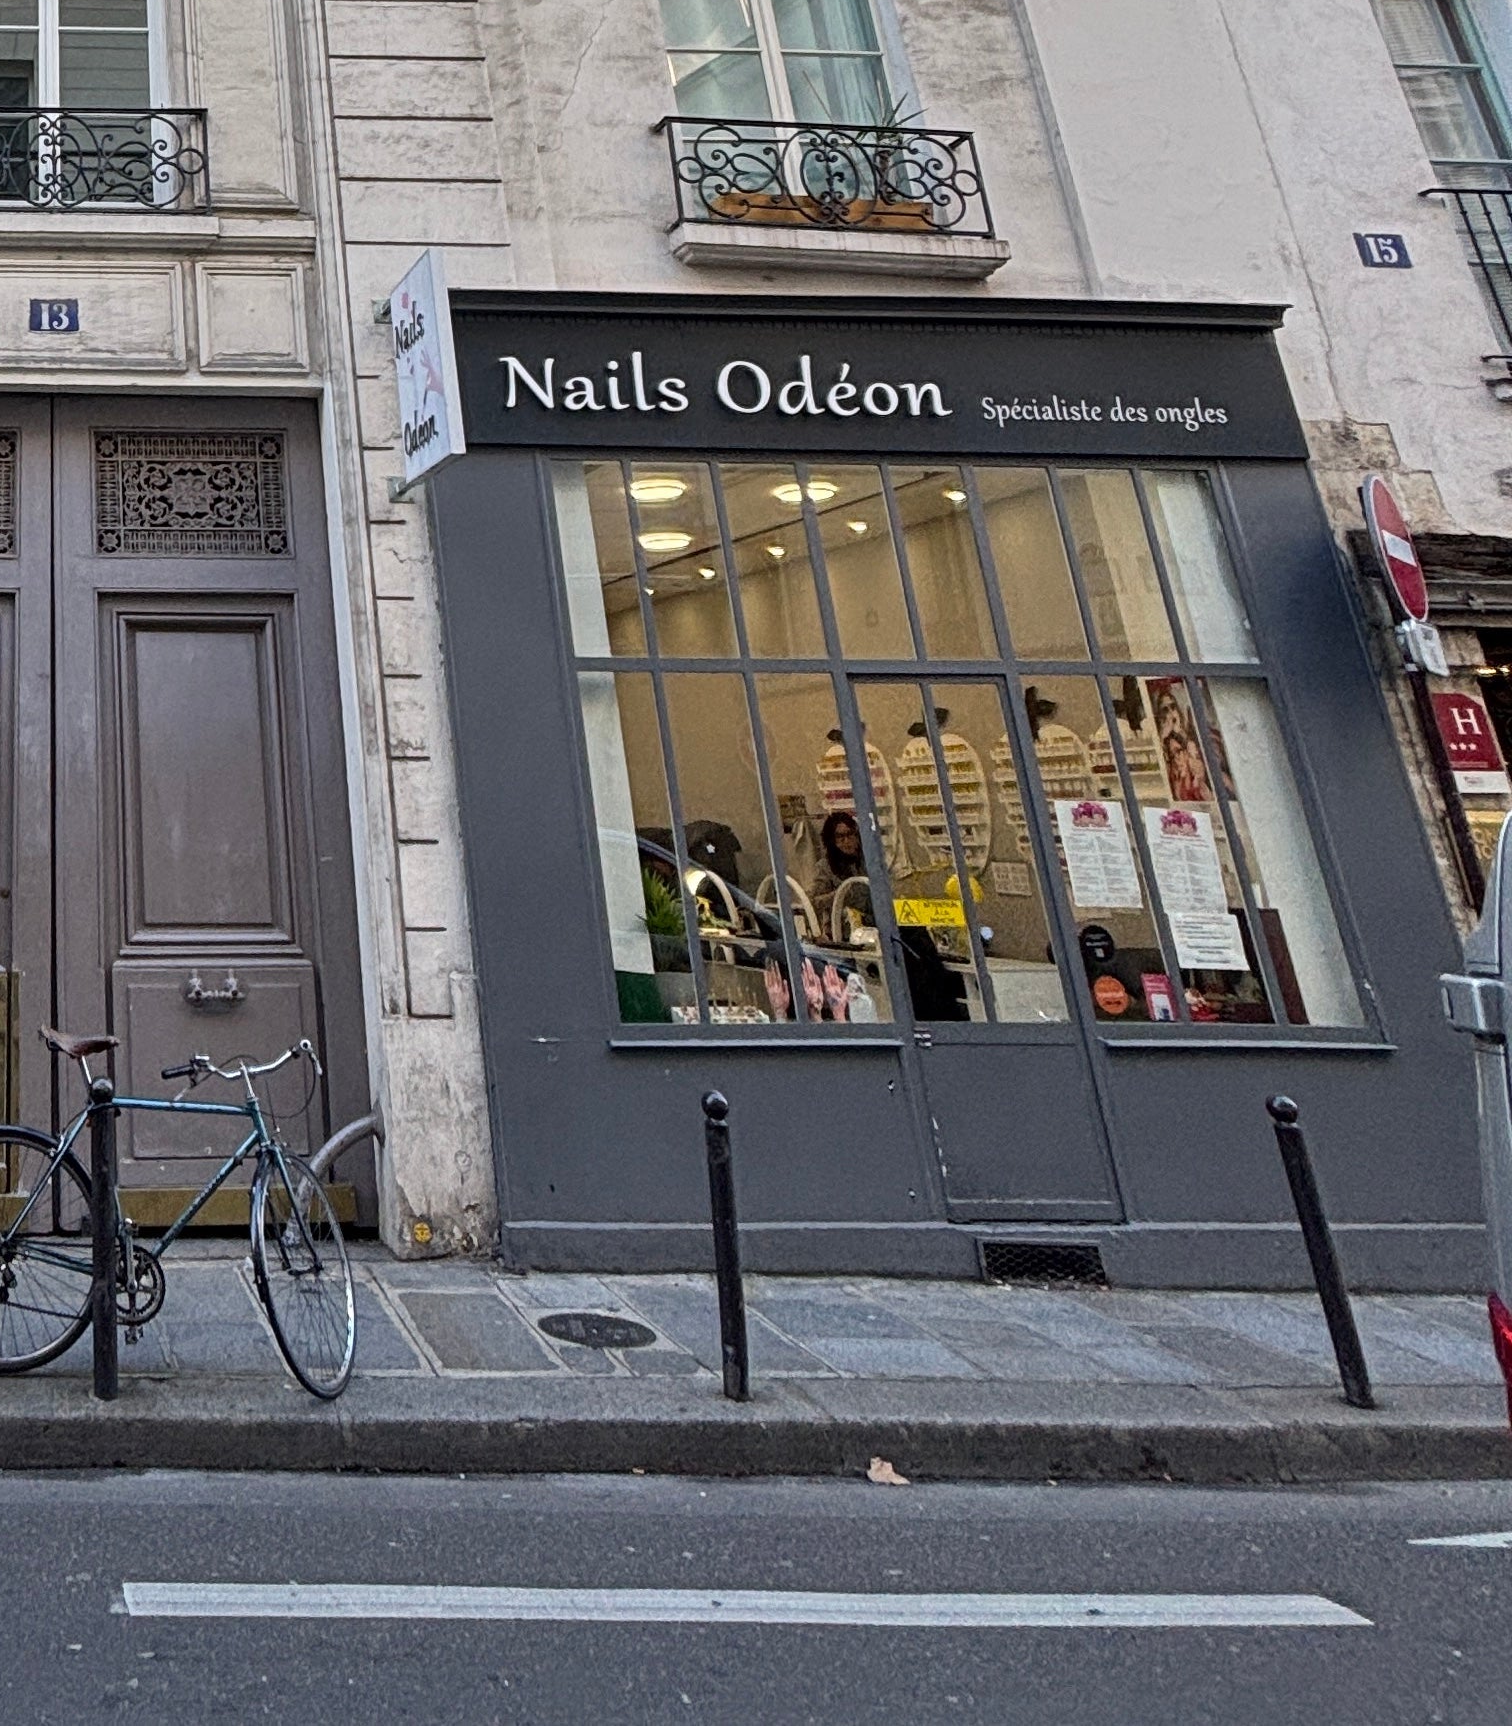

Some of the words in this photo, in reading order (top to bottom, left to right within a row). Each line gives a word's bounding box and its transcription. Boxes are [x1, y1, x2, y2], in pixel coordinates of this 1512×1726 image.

[1365, 237, 1399, 264] 15
[40, 303, 70, 330] 13
[394, 300, 425, 360] Nails
[499, 351, 689, 412] Nails
[716, 355, 953, 417] Odéon
[981, 394, 1103, 428] Spécialiste
[1109, 395, 1149, 423] des
[1155, 397, 1228, 432] ongles
[1450, 707, 1483, 736] H
